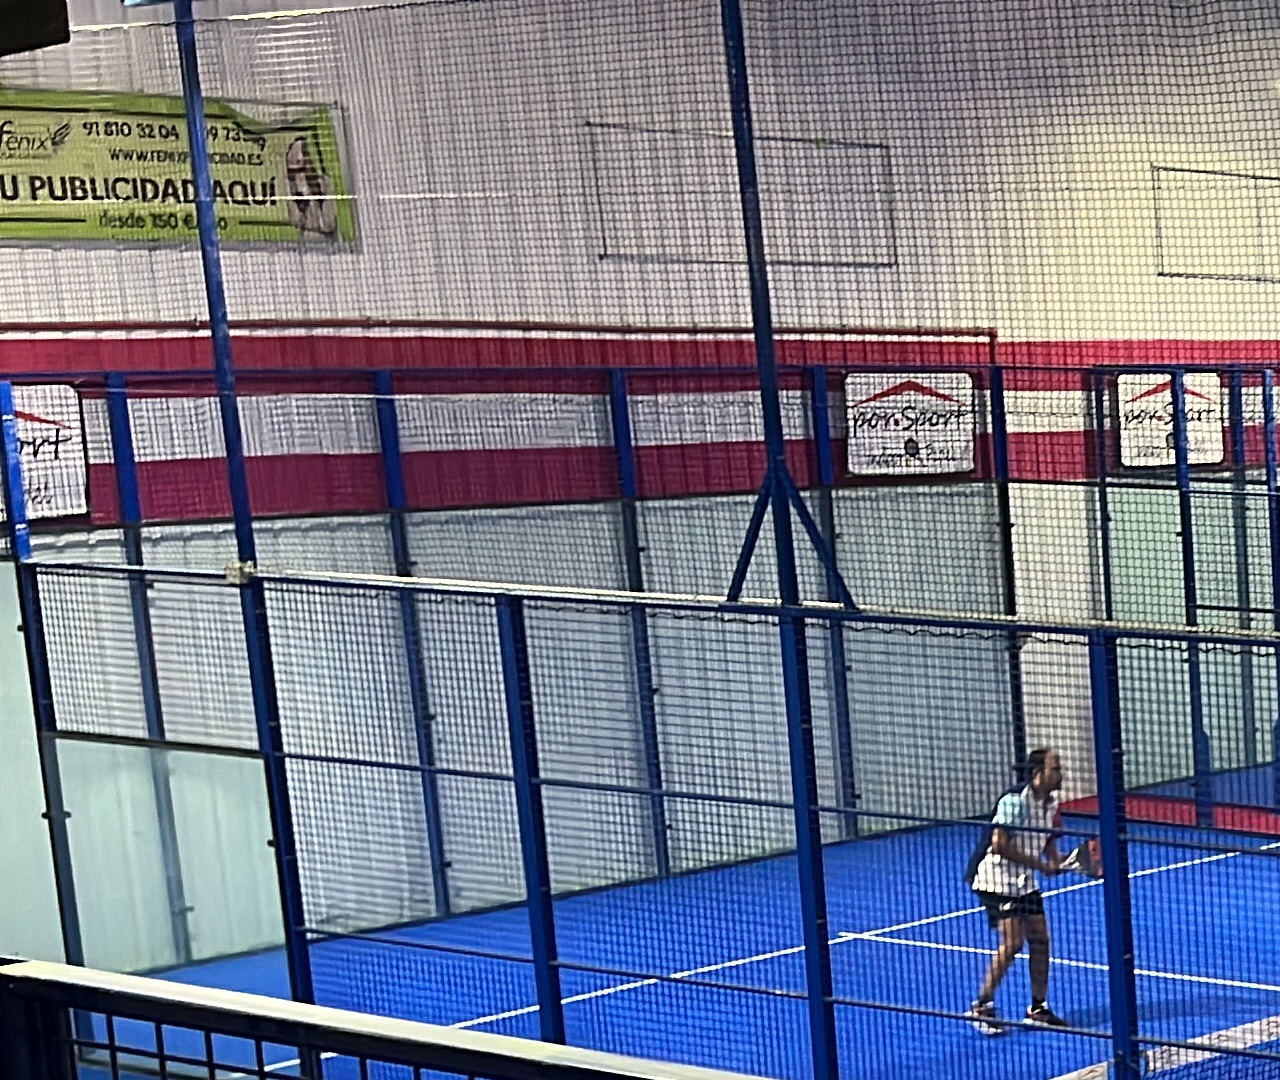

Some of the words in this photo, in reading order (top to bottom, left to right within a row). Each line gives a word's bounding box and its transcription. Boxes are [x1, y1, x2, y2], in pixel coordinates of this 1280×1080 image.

[0, 174, 19, 201] U
[29, 175, 197, 204] PUBLICIDAD
[212, 176, 277, 206] AQUÍ
